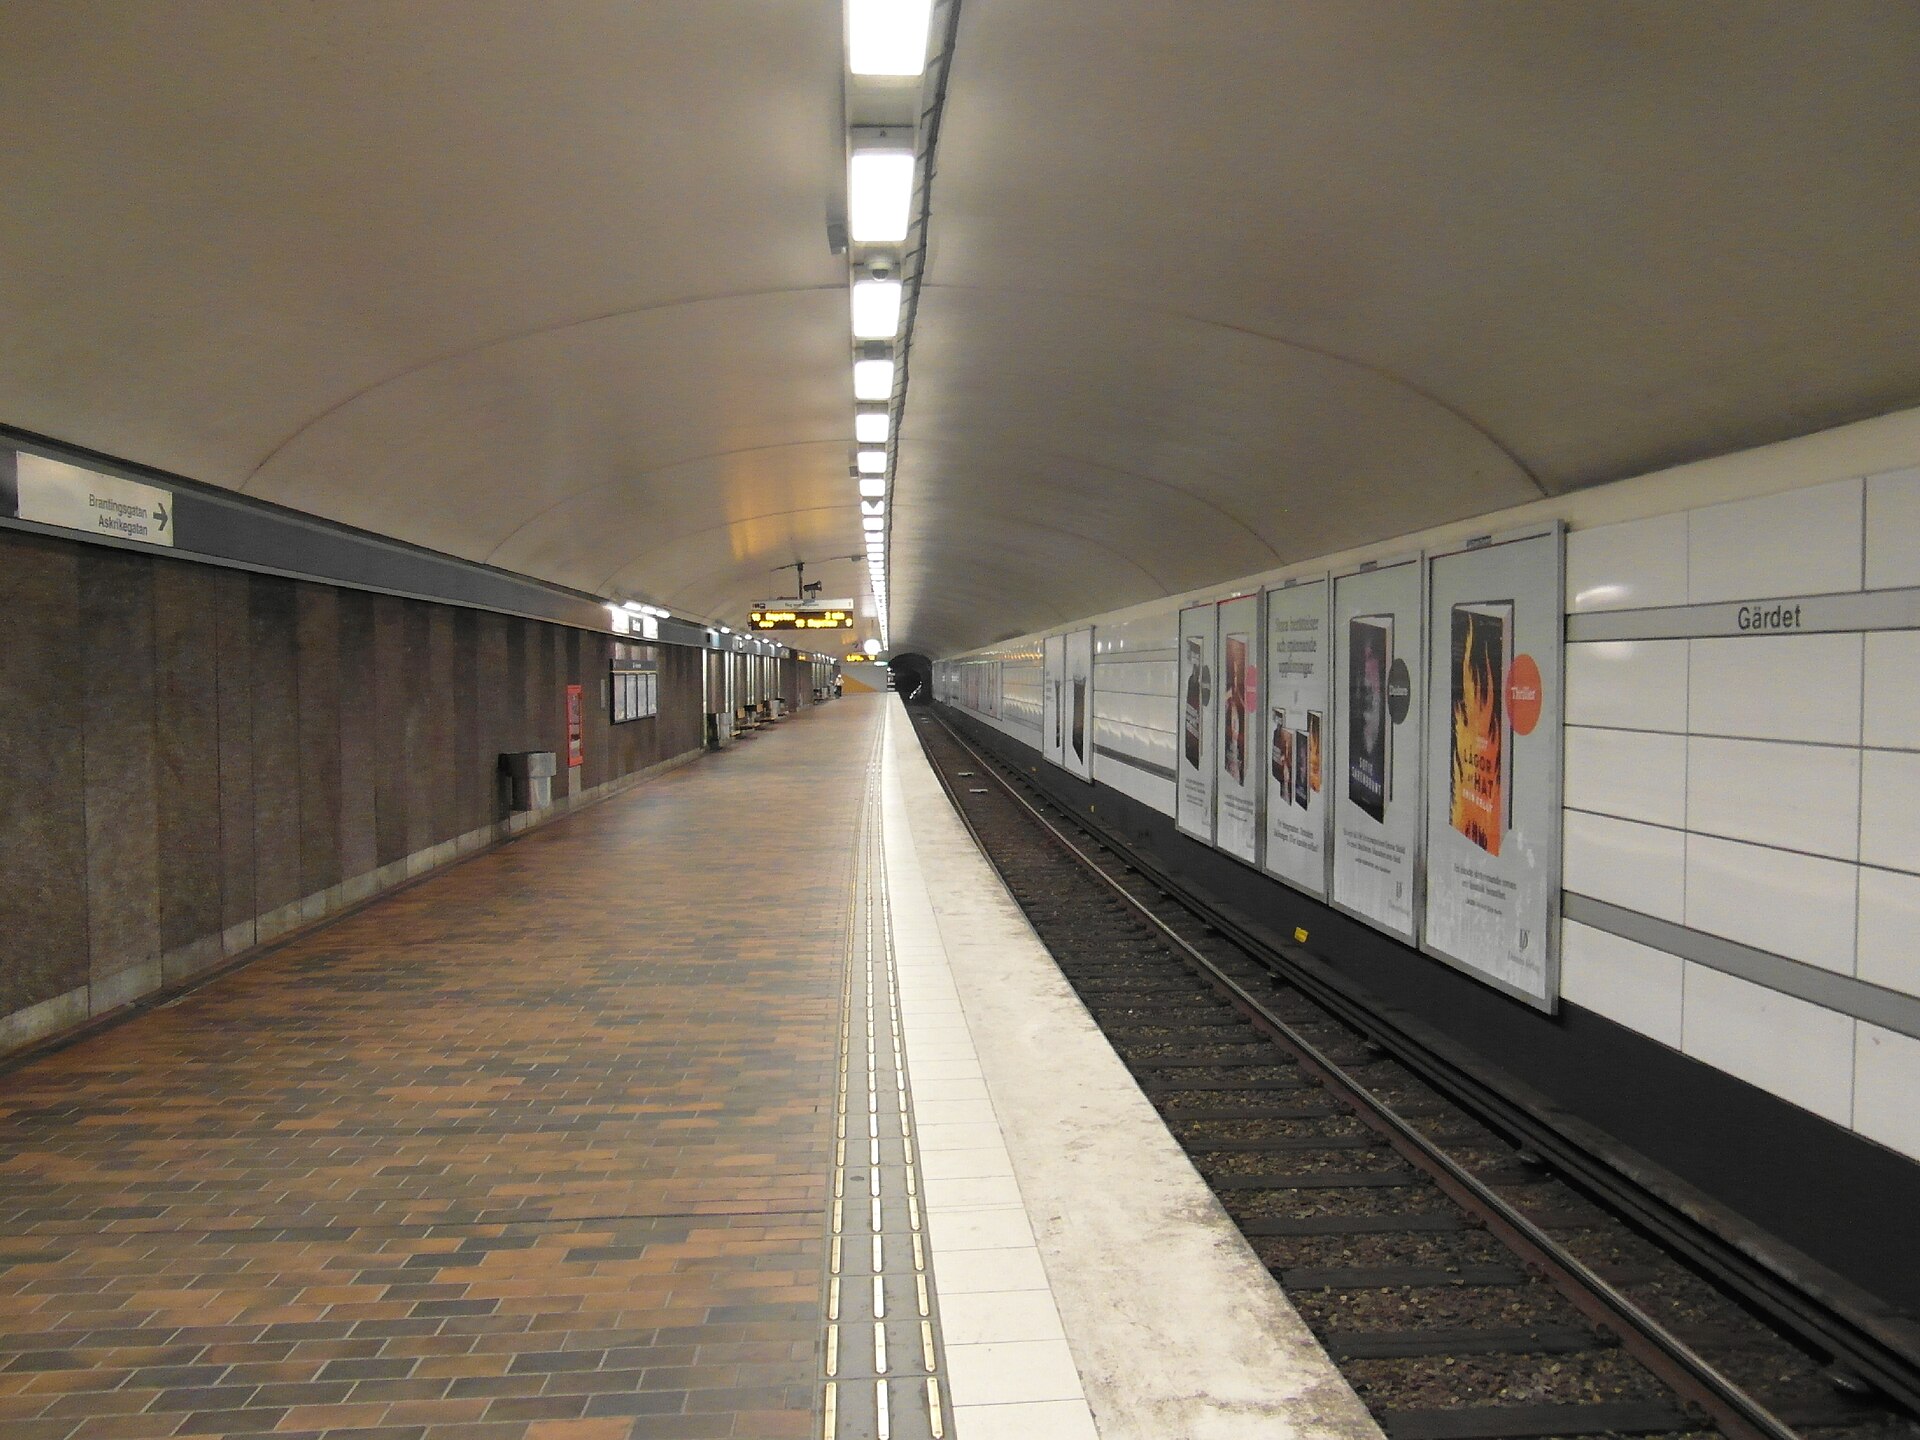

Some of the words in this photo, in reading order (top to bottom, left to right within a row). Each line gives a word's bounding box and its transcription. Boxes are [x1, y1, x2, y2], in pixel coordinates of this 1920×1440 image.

[1738, 604, 1801, 631] Gärdet
[1511, 687, 1536, 701] Thriller
[1474, 772, 1493, 799] HAT
